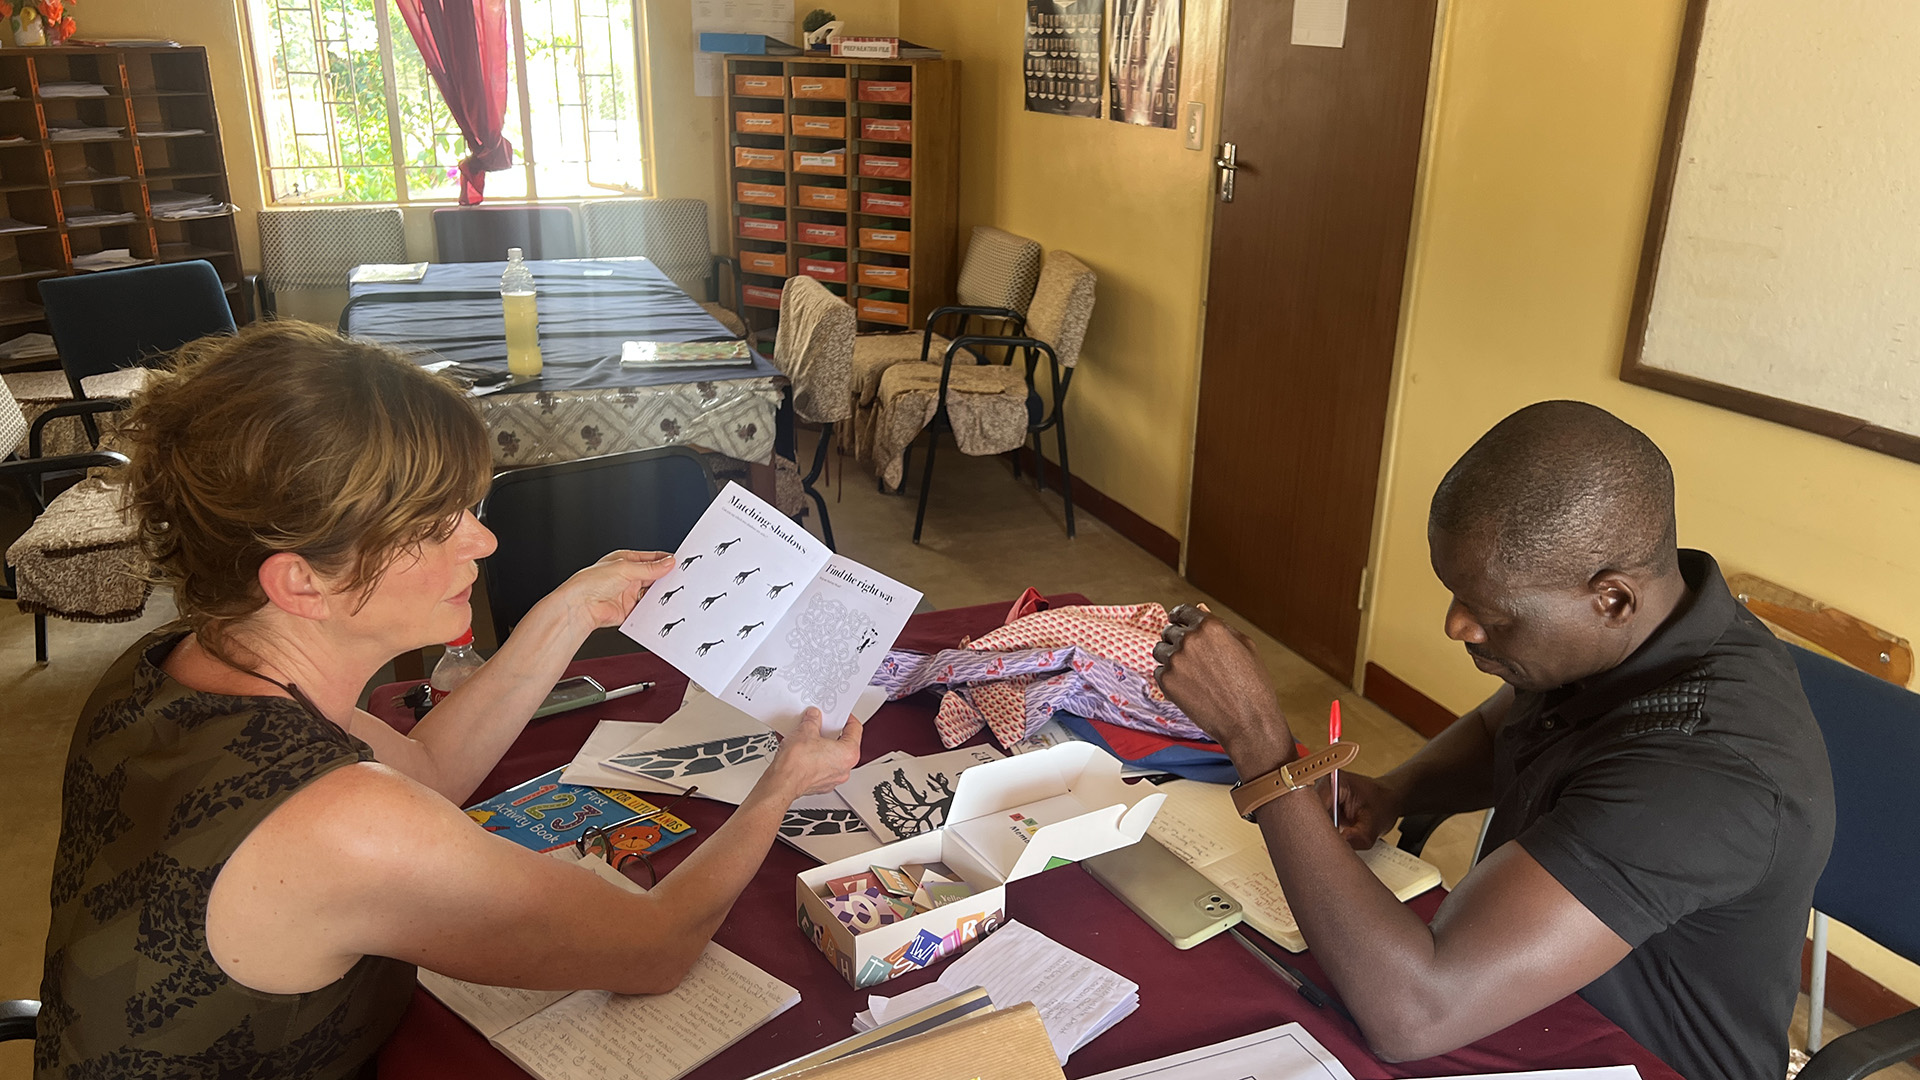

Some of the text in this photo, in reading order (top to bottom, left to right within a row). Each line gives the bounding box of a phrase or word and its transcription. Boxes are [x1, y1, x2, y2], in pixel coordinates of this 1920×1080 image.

[728, 495, 772, 530] Matching
[770, 524, 807, 555] shadows
[825, 563, 845, 581] Find
[842, 570, 859, 588] the
[859, 577, 882, 598] right
[878, 591, 896, 606] way
[511, 784, 558, 807] 1
[524, 793, 577, 820] 2
[583, 790, 608, 807] First
[613, 791, 631, 803] FOR
[491, 802, 560, 844] Activity Book
[550, 804, 603, 832] 3
[909, 934, 939, 961] W
[962, 919, 977, 940] R
[841, 958, 850, 981] H
